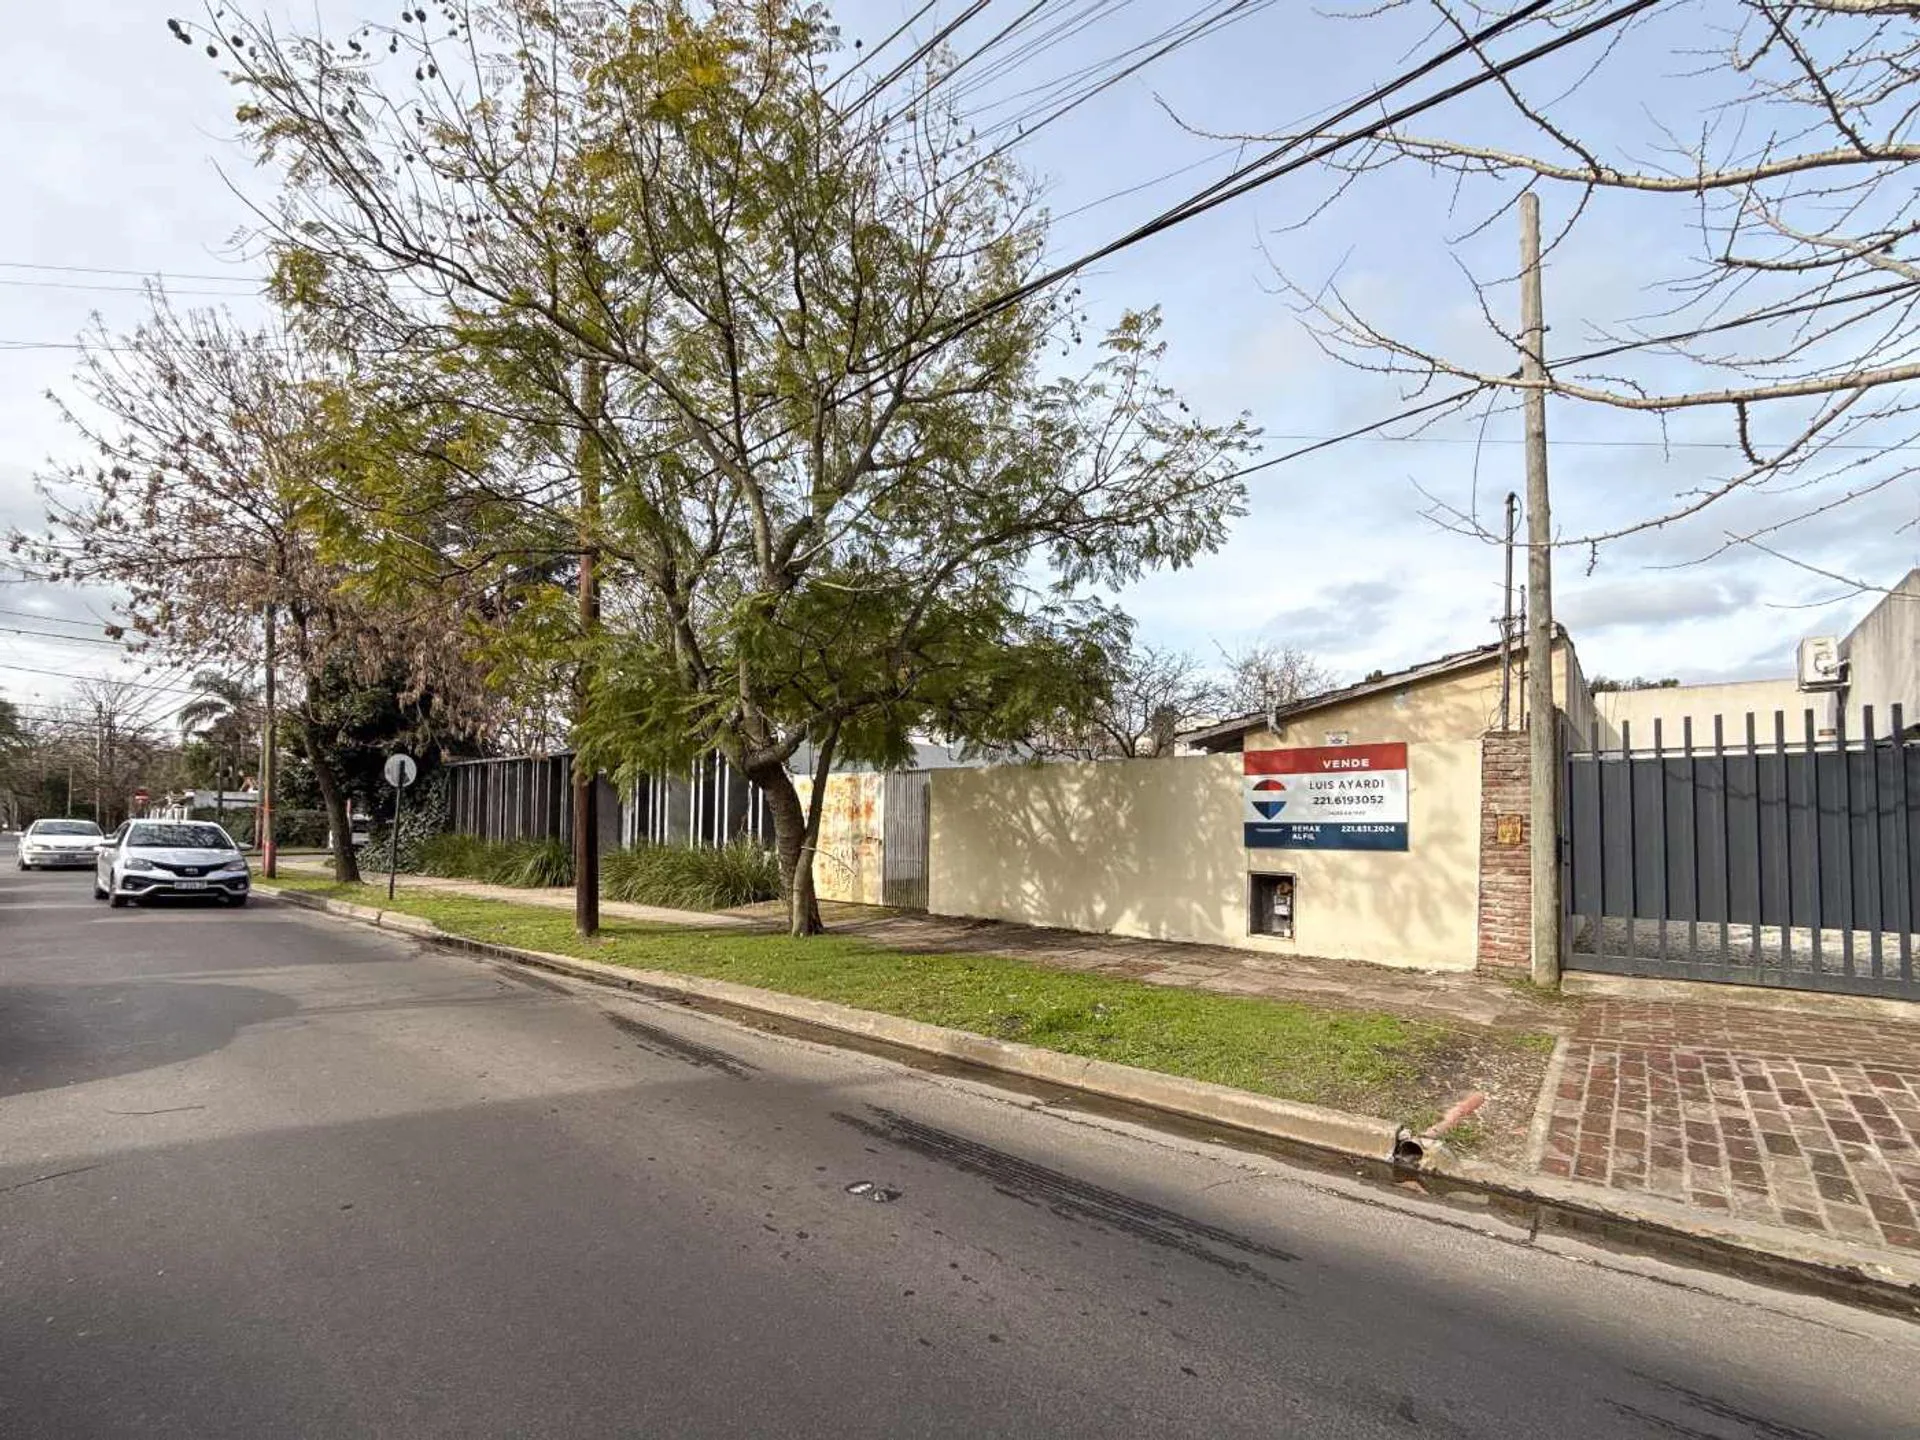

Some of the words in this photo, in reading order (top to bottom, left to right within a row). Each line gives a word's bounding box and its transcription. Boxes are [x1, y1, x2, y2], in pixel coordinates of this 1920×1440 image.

[1322, 758, 1370, 769] VENDE
[1309, 780, 1335, 790] LUIS
[1338, 779, 1385, 790] AYARDI
